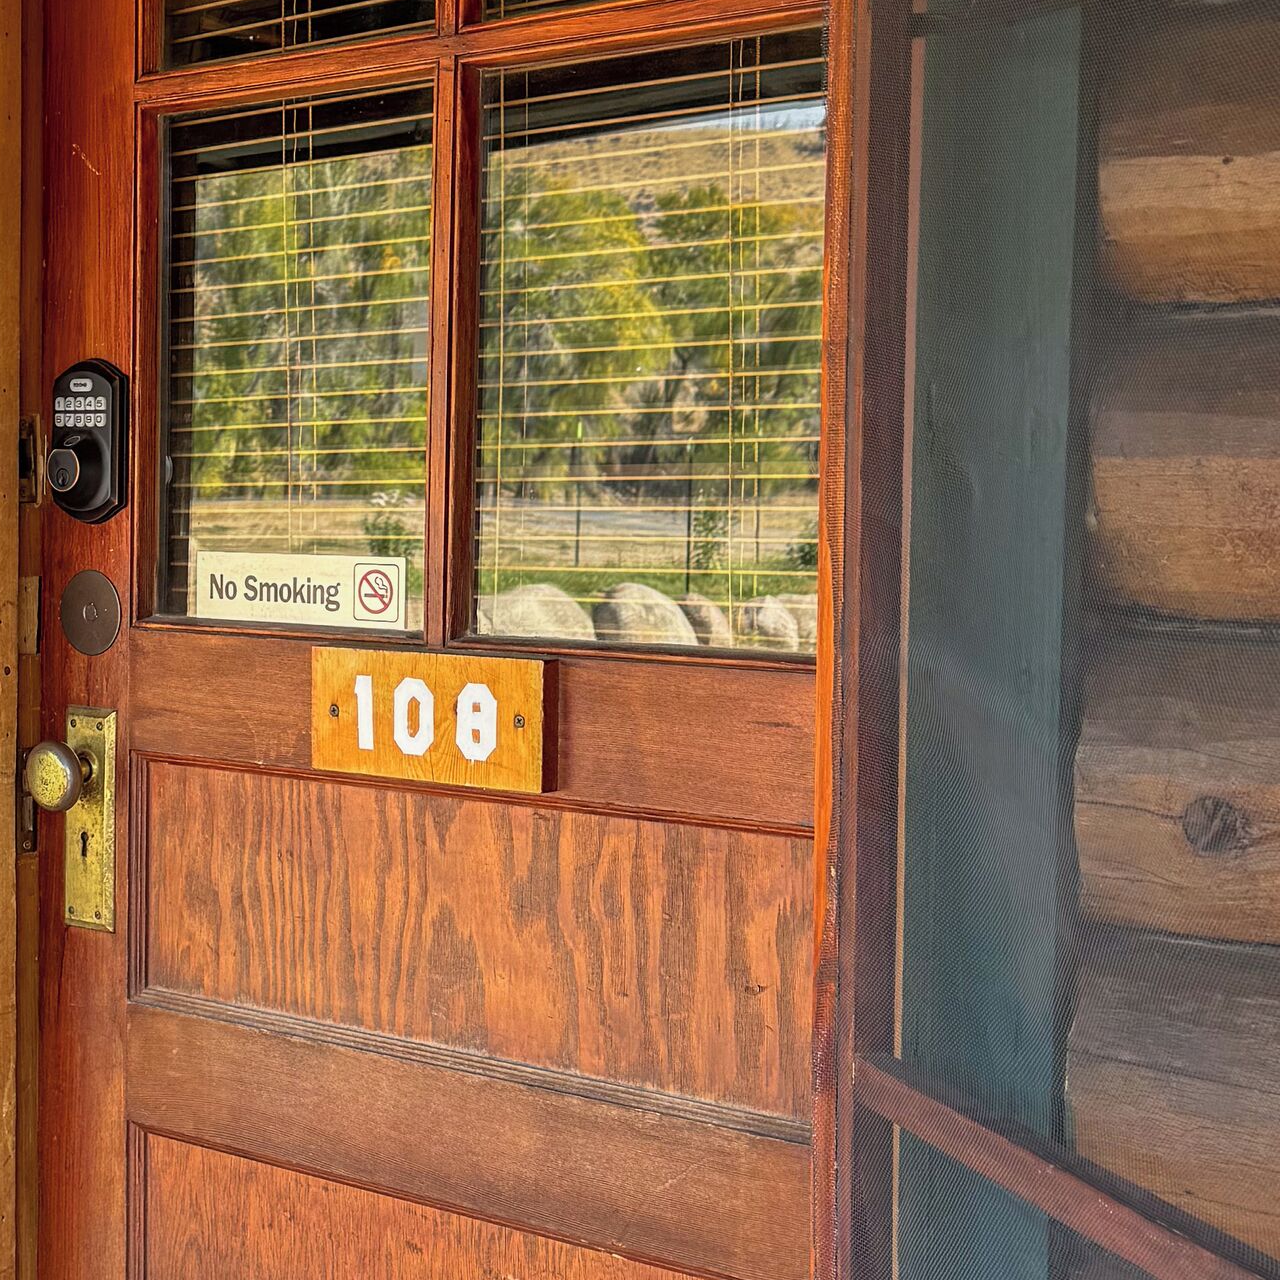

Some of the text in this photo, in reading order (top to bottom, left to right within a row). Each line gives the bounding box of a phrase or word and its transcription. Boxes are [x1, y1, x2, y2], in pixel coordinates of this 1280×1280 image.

[209, 573, 341, 612] No Smoking
[354, 675, 498, 762] 108
